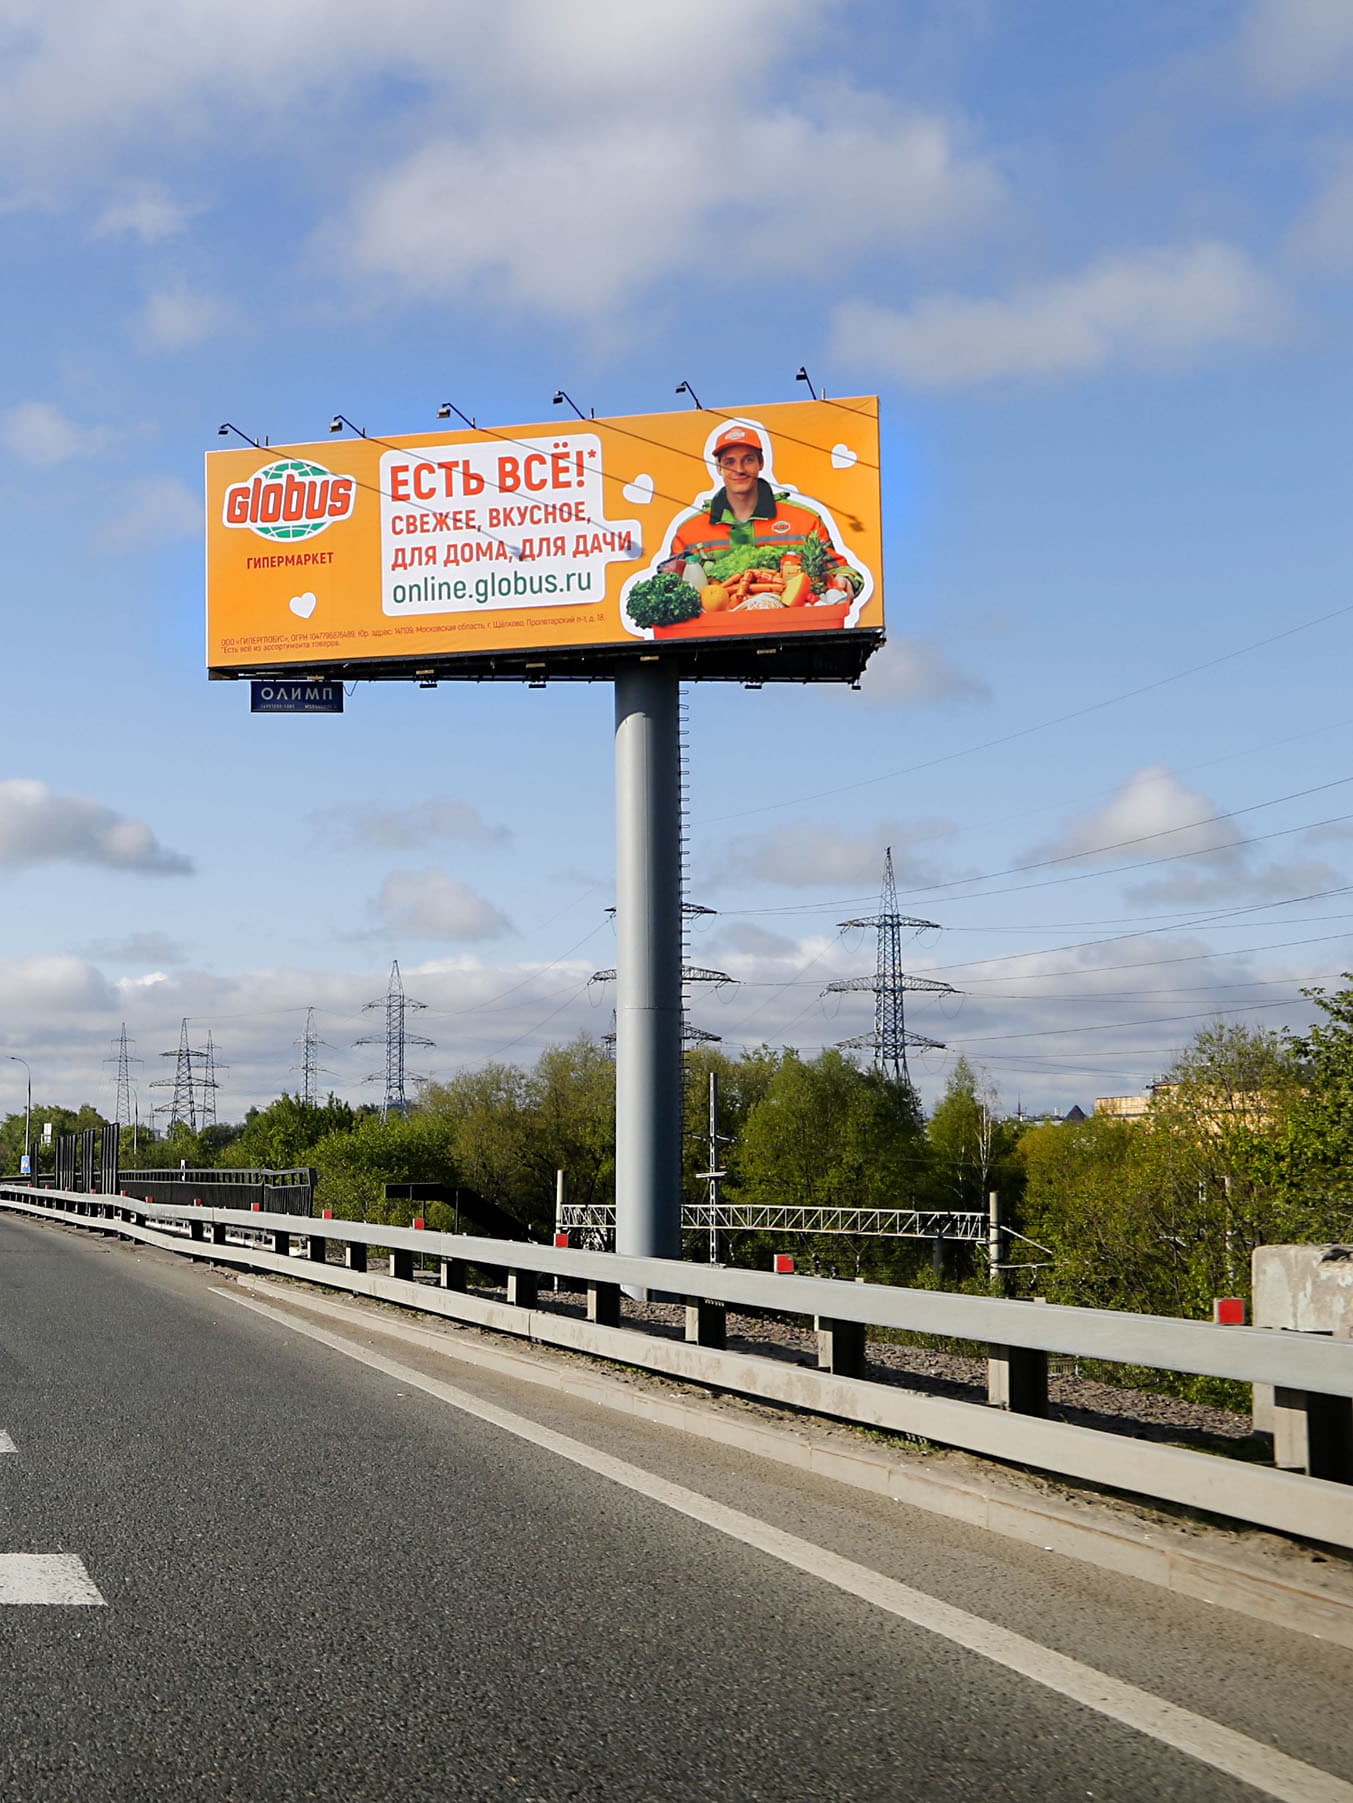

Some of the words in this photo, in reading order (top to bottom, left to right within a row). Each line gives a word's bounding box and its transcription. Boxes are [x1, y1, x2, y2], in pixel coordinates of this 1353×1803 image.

[390, 459, 485, 502] ЕСТЬ
[226, 473, 353, 524] Globus
[391, 509, 483, 535] СВЕЖЕЕ,
[488, 501, 592, 528] ВКУСНОЕ,
[246, 552, 334, 569] ГИПЕРМАРКЕТ
[391, 545, 437, 571] ДЛЯ
[443, 540, 513, 567] ДОМА,
[519, 536, 566, 562] ДЛЯ
[572, 531, 632, 558] ДАЧИ
[392, 570, 592, 604] online.globus.ru
[261, 687, 333, 700] ОЛИМП
